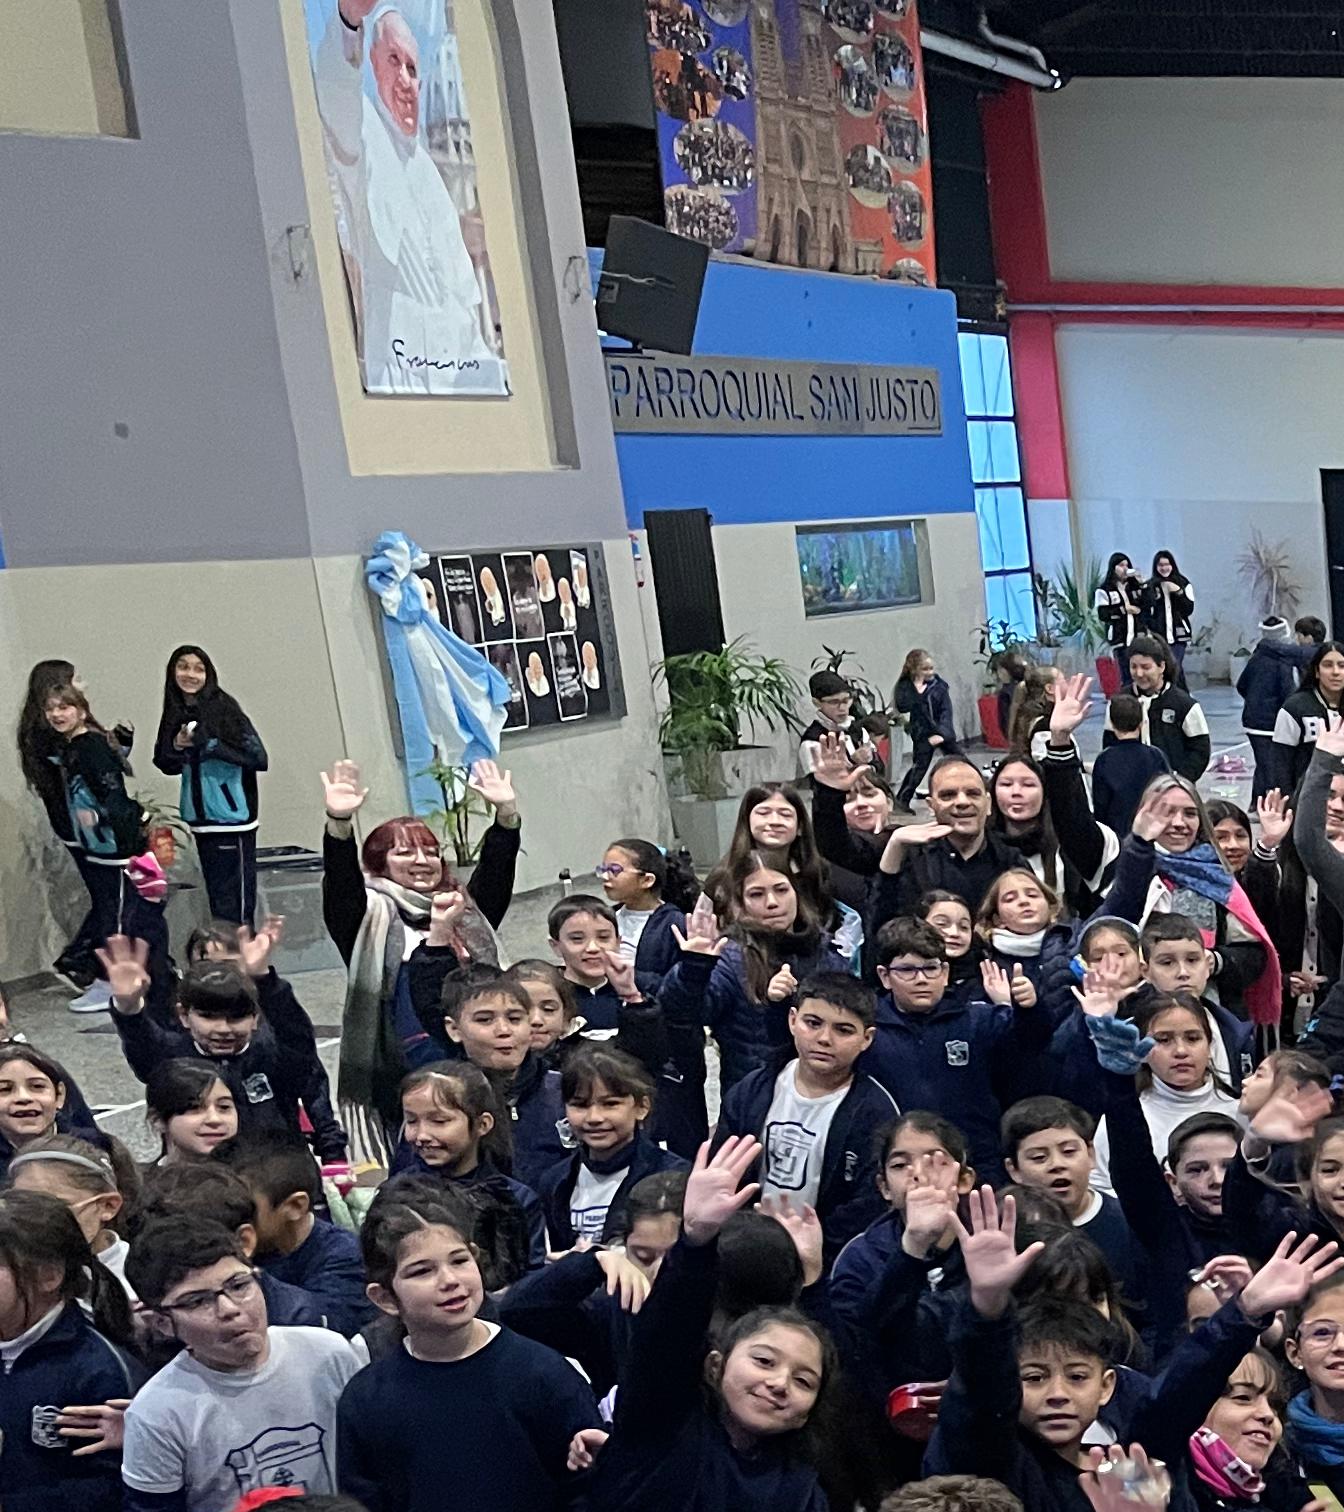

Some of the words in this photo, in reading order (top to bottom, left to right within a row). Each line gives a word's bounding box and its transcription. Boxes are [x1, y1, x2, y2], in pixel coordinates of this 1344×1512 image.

[609, 364, 804, 422] PARROQUIAL
[808, 373, 860, 422] SAN
[865, 377, 937, 422] JUSTO
